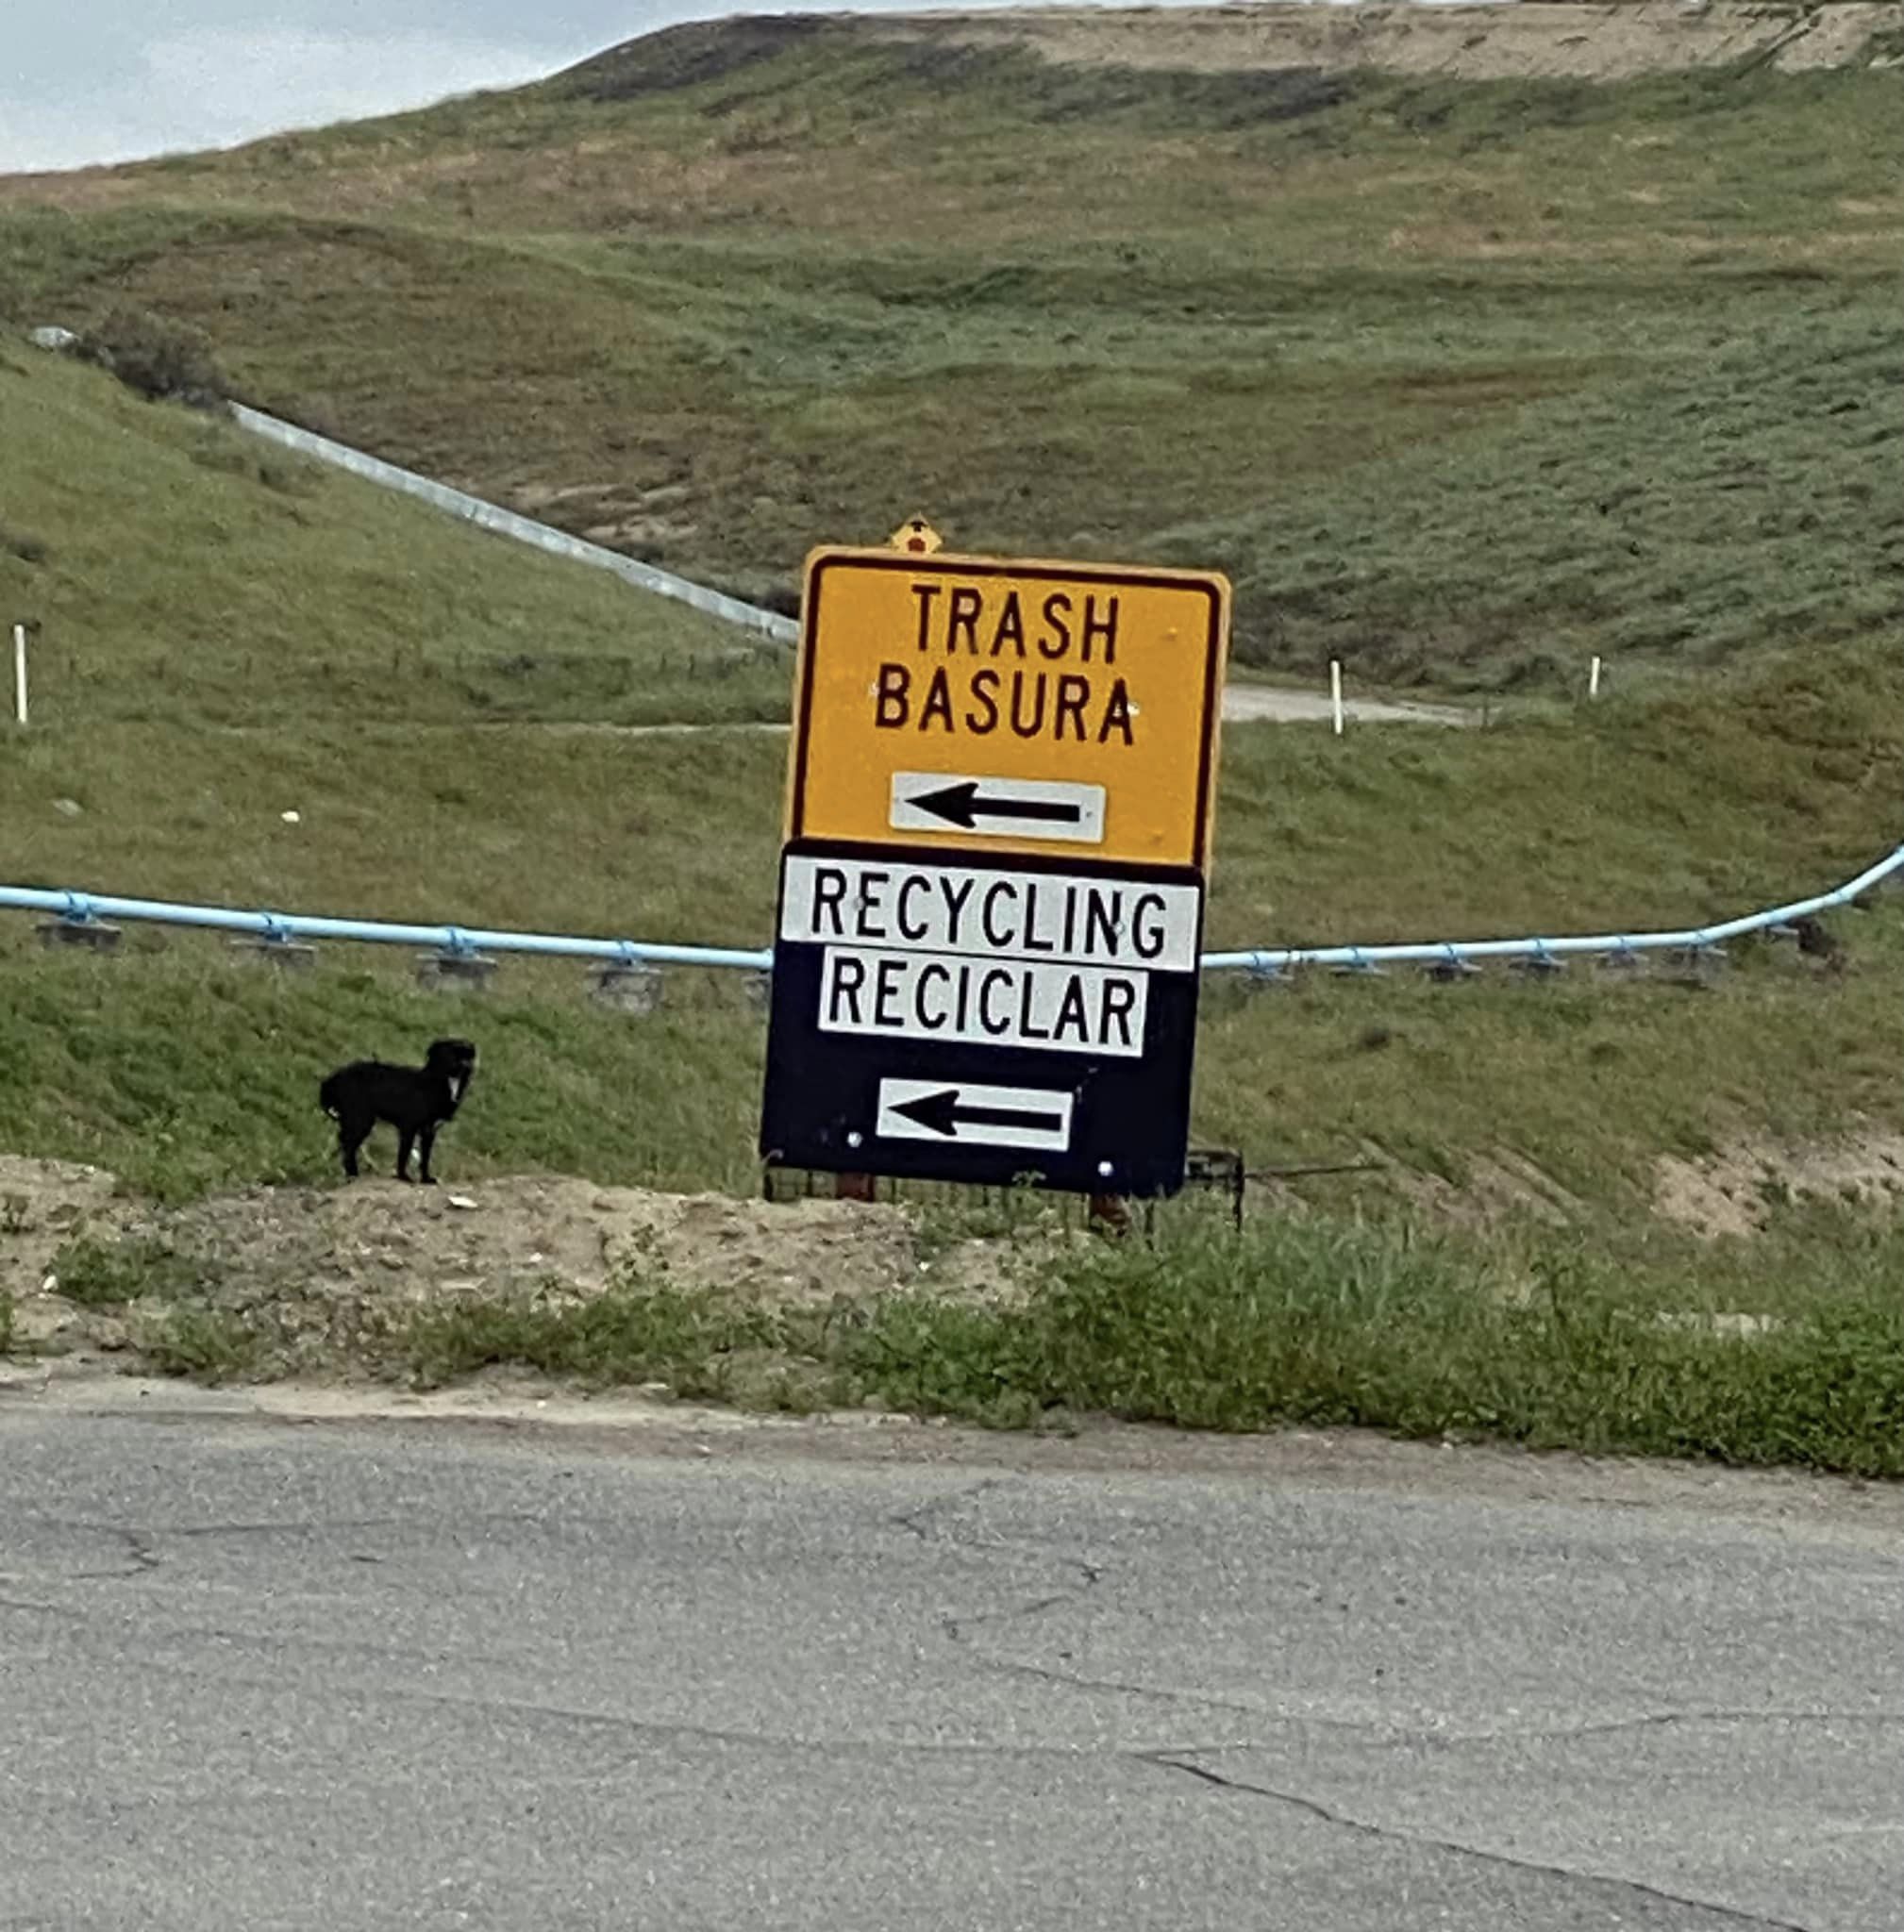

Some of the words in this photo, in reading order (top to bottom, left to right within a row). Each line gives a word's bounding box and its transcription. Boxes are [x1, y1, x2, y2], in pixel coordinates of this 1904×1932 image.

[911, 584, 1119, 664] TRASH
[875, 663, 1135, 746] BASURA
[811, 867, 1166, 958] RECYCLING
[828, 956, 1136, 1045] RECICLAR
